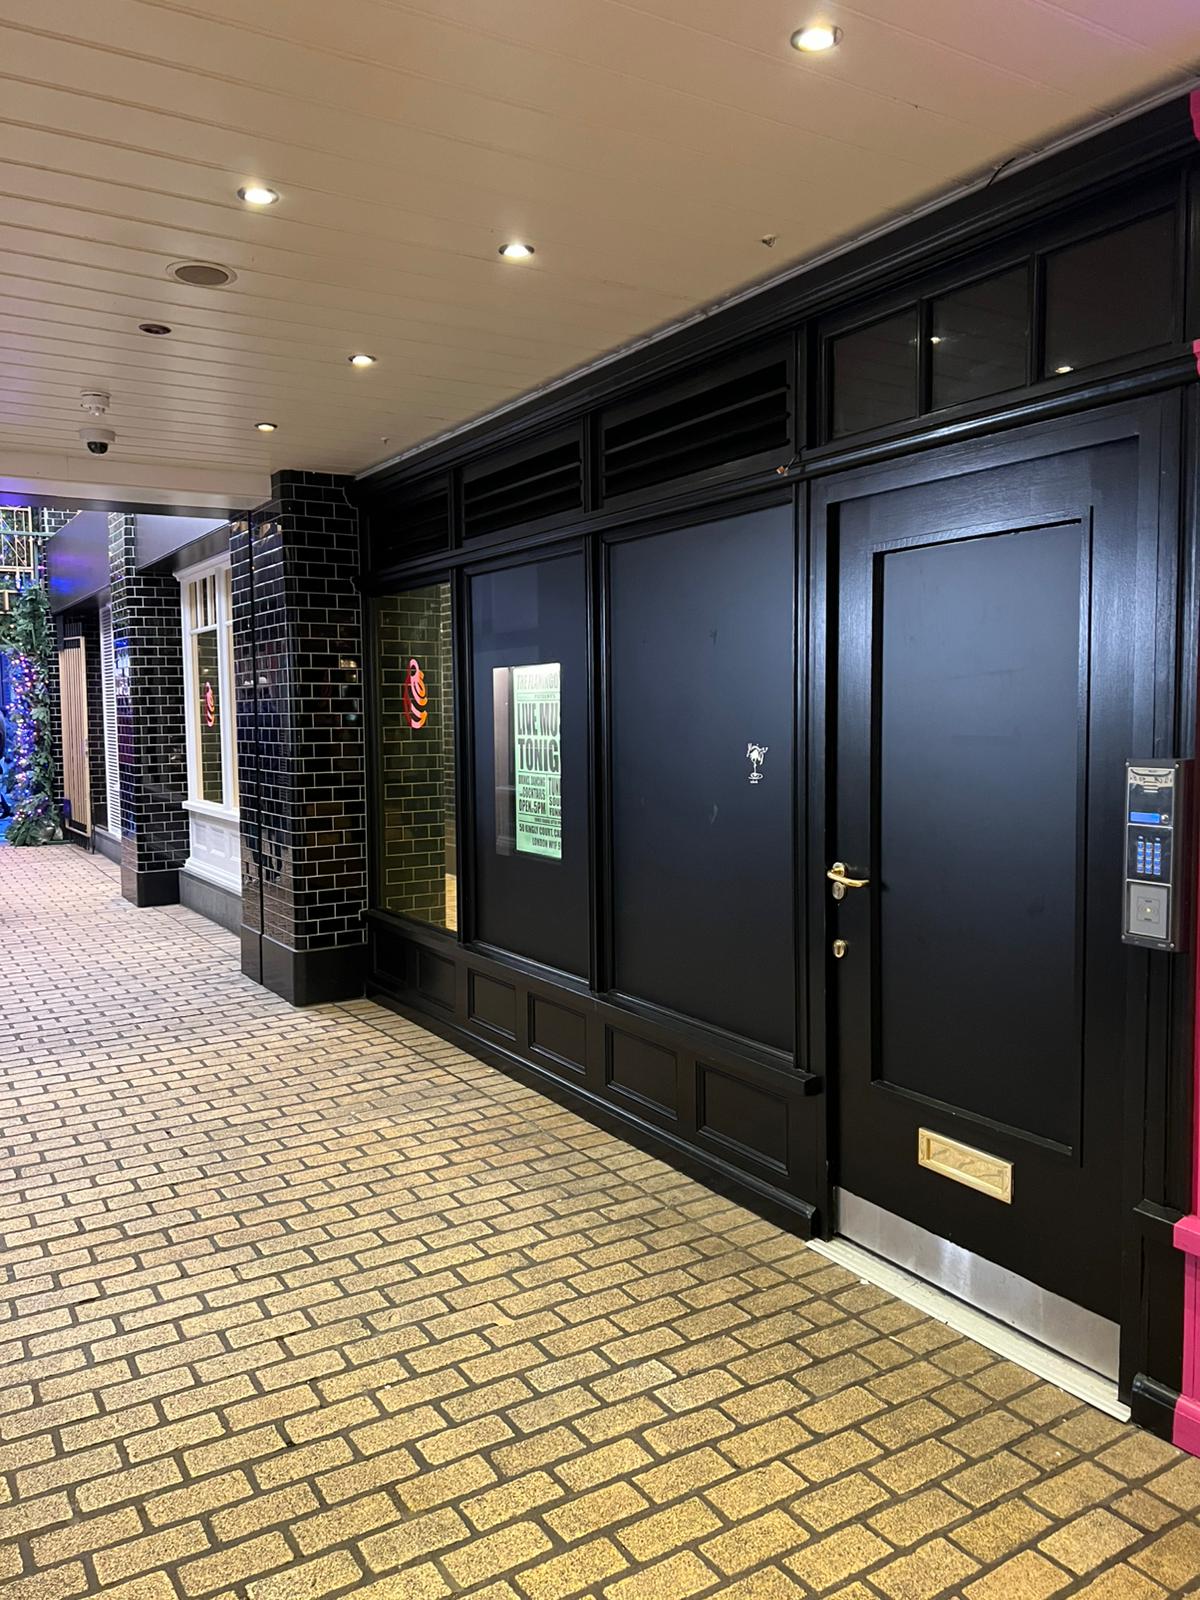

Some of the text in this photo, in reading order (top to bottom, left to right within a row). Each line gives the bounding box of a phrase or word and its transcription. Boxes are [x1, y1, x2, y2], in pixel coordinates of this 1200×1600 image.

[518, 702, 560, 736] LIVE MU
[518, 738, 559, 772] TONIG
[518, 798, 546, 814] OPEN 5PM
[549, 796, 560, 806] SOU
[532, 837, 548, 848] LONDON
